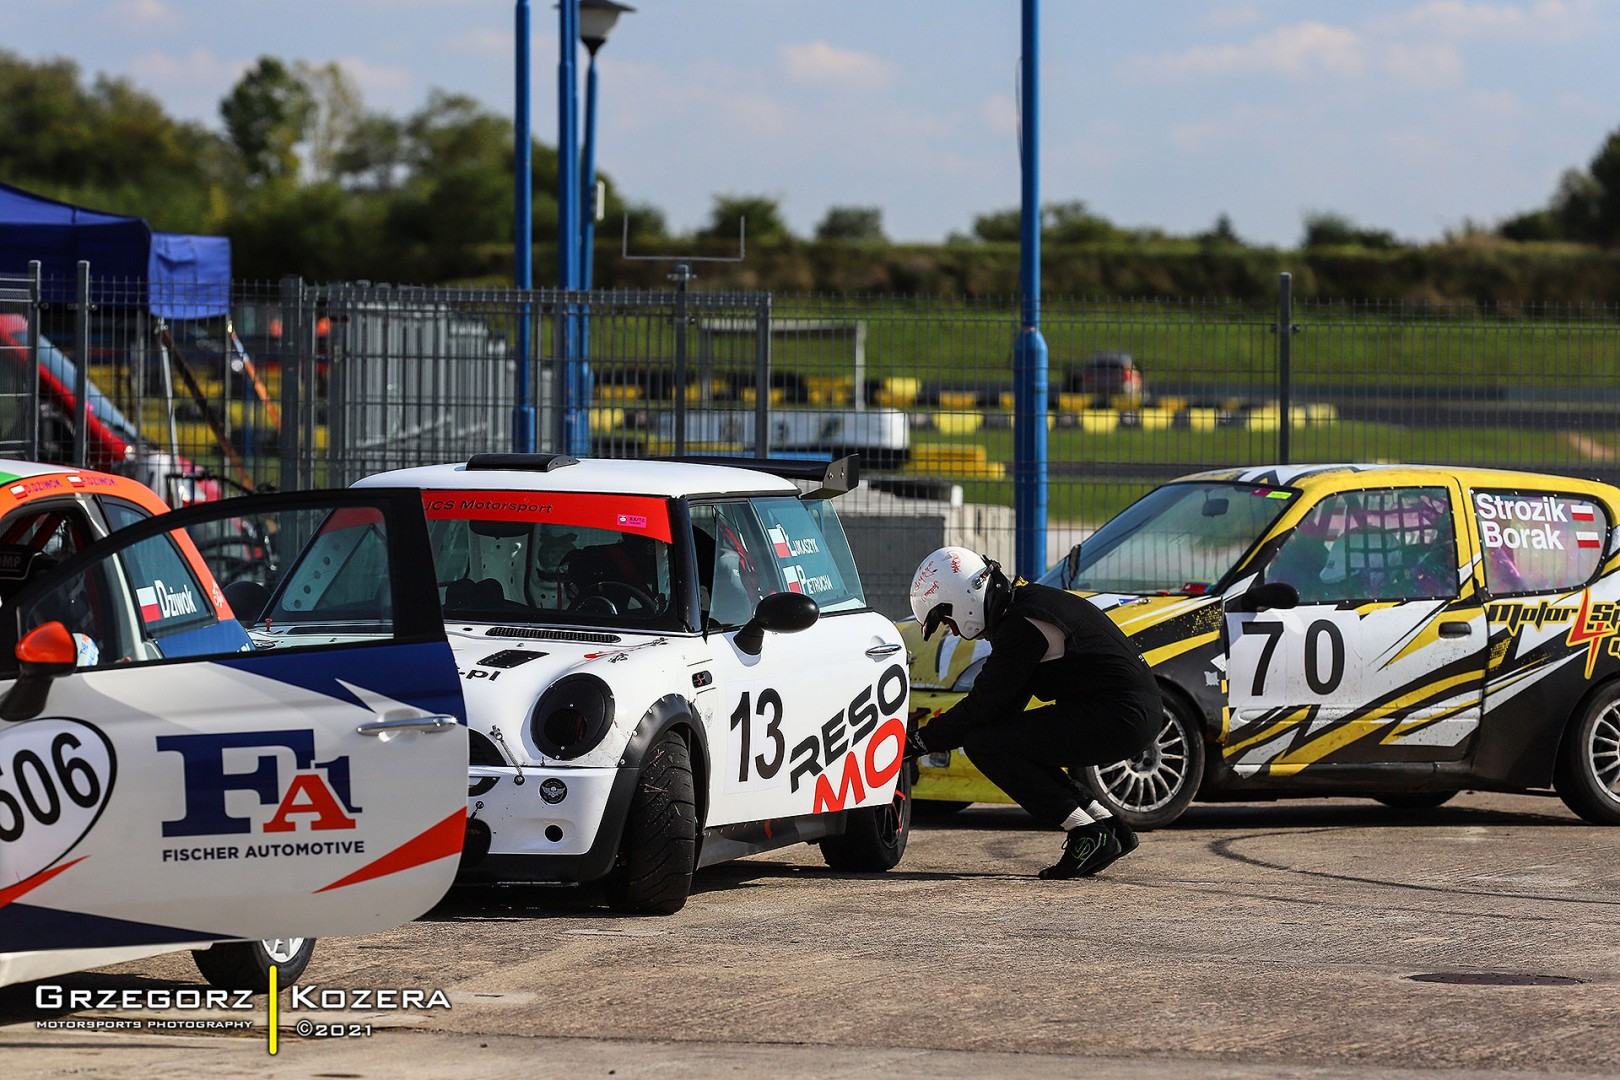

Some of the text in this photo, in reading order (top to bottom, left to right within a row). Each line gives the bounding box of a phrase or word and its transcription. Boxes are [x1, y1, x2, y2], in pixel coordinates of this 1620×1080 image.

[460, 499, 553, 513] Motorsport
[1476, 493, 1568, 522] Strozik
[1481, 523, 1565, 550] Borak
[1241, 619, 1345, 696] 70
[730, 687, 786, 783] 13
[789, 664, 908, 794] RESO
[813, 717, 907, 814] MO
[162, 840, 365, 862] FISCHER AUTOMOTIVE
